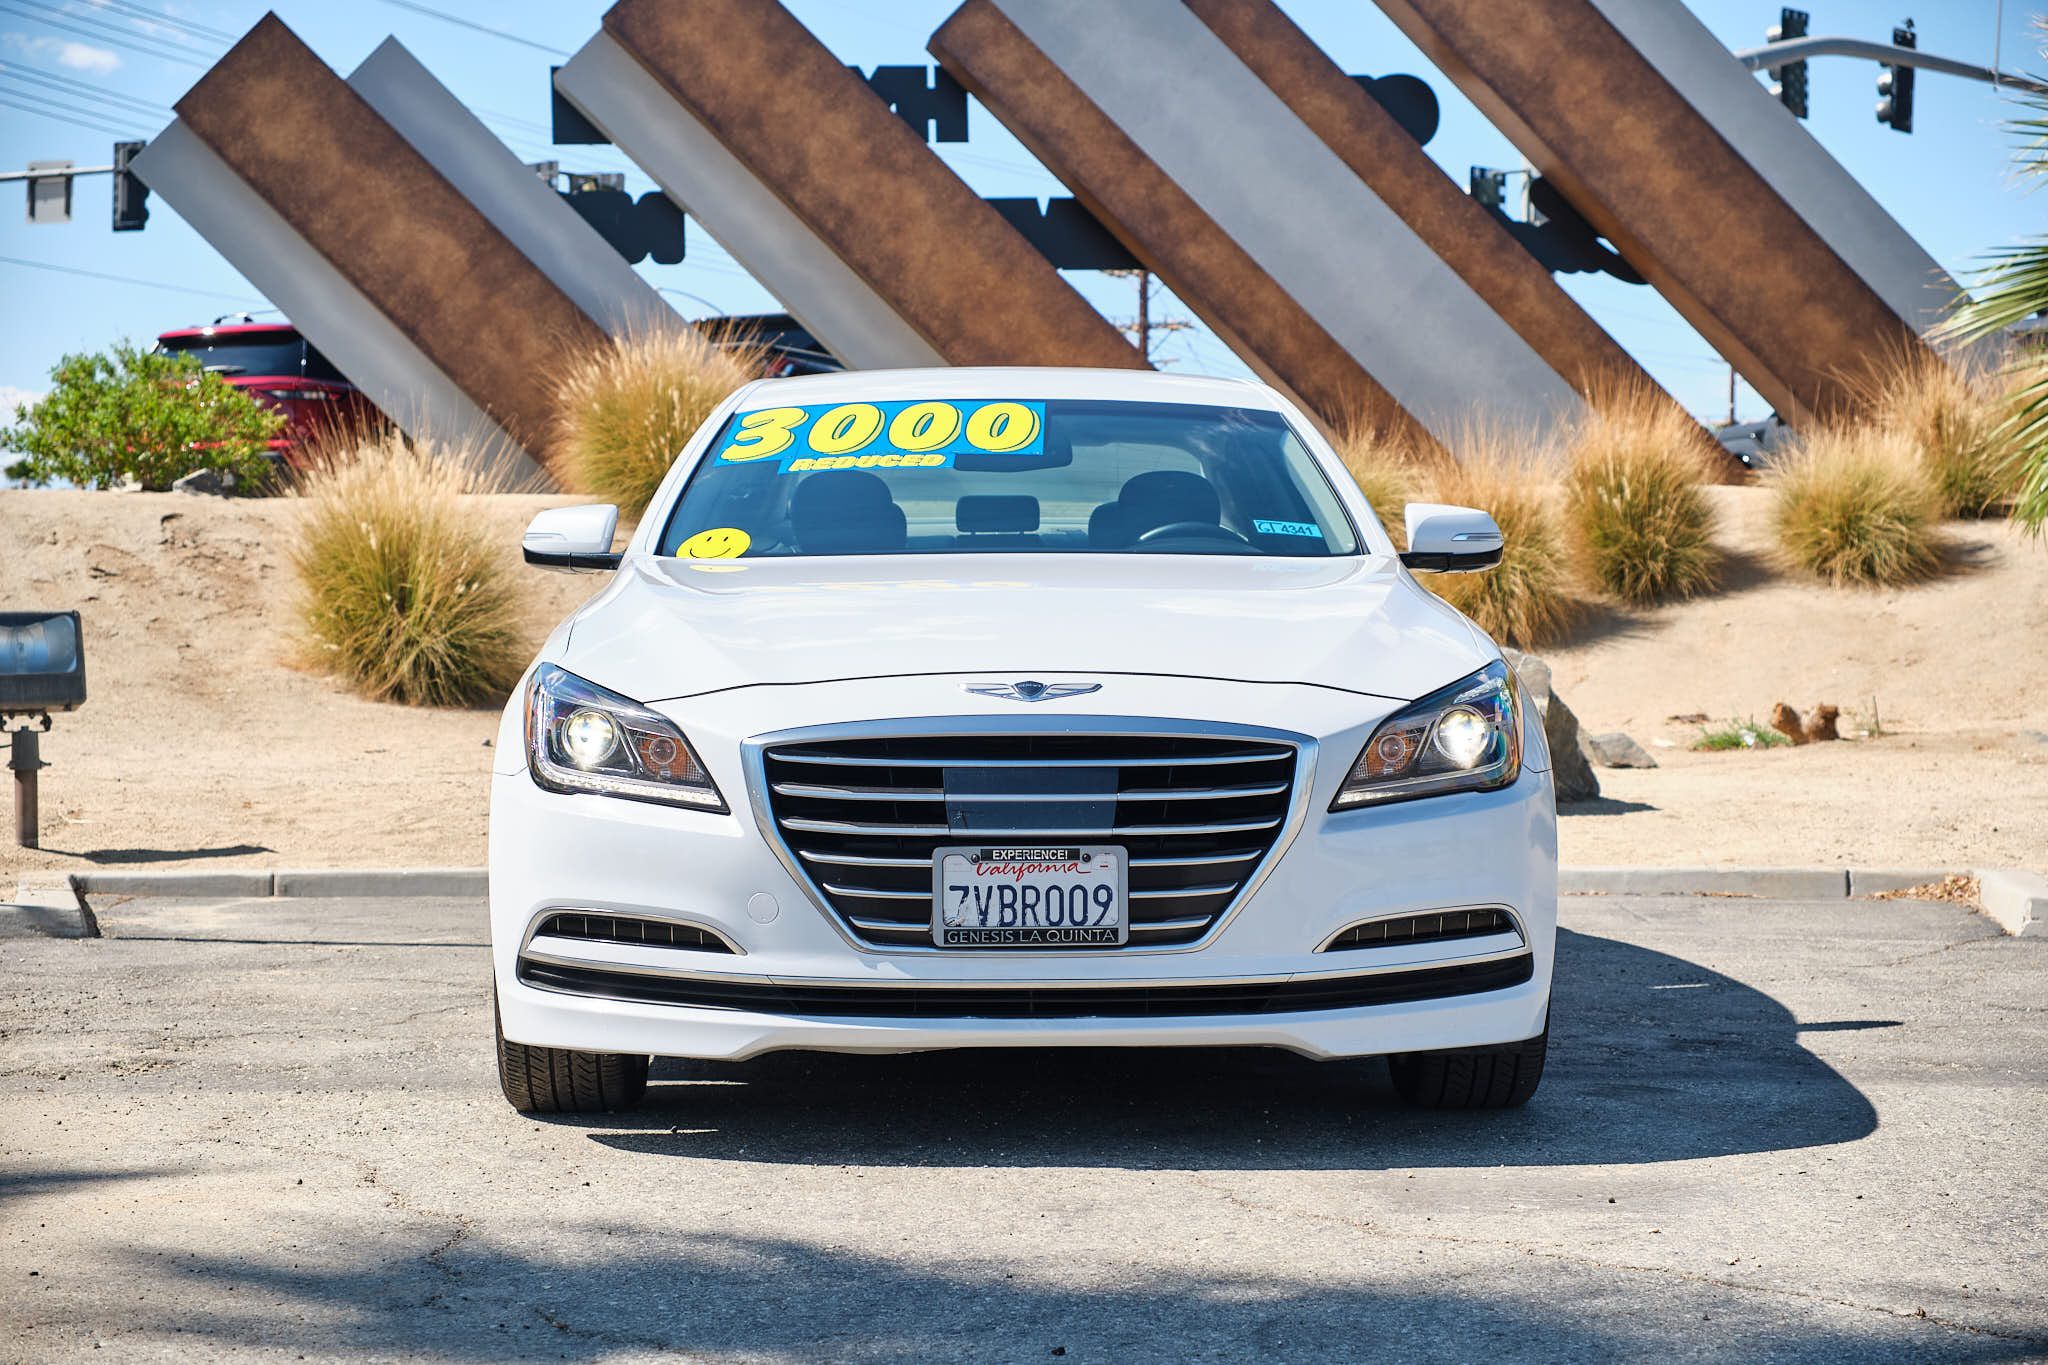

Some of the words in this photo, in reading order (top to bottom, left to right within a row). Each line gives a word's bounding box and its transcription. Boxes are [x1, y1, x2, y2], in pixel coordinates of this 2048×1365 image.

[720, 402, 1041, 461] 3000
[788, 454, 947, 472] REDUCED
[1281, 524, 1314, 536] 4341
[992, 849, 1068, 861] EXPERIENCE!
[976, 861, 1092, 882] California
[948, 884, 1114, 927] 7VBR009
[947, 930, 1014, 944] GENESIS
[1019, 930, 1042, 943] LA
[1046, 929, 1116, 942] QUINTA
